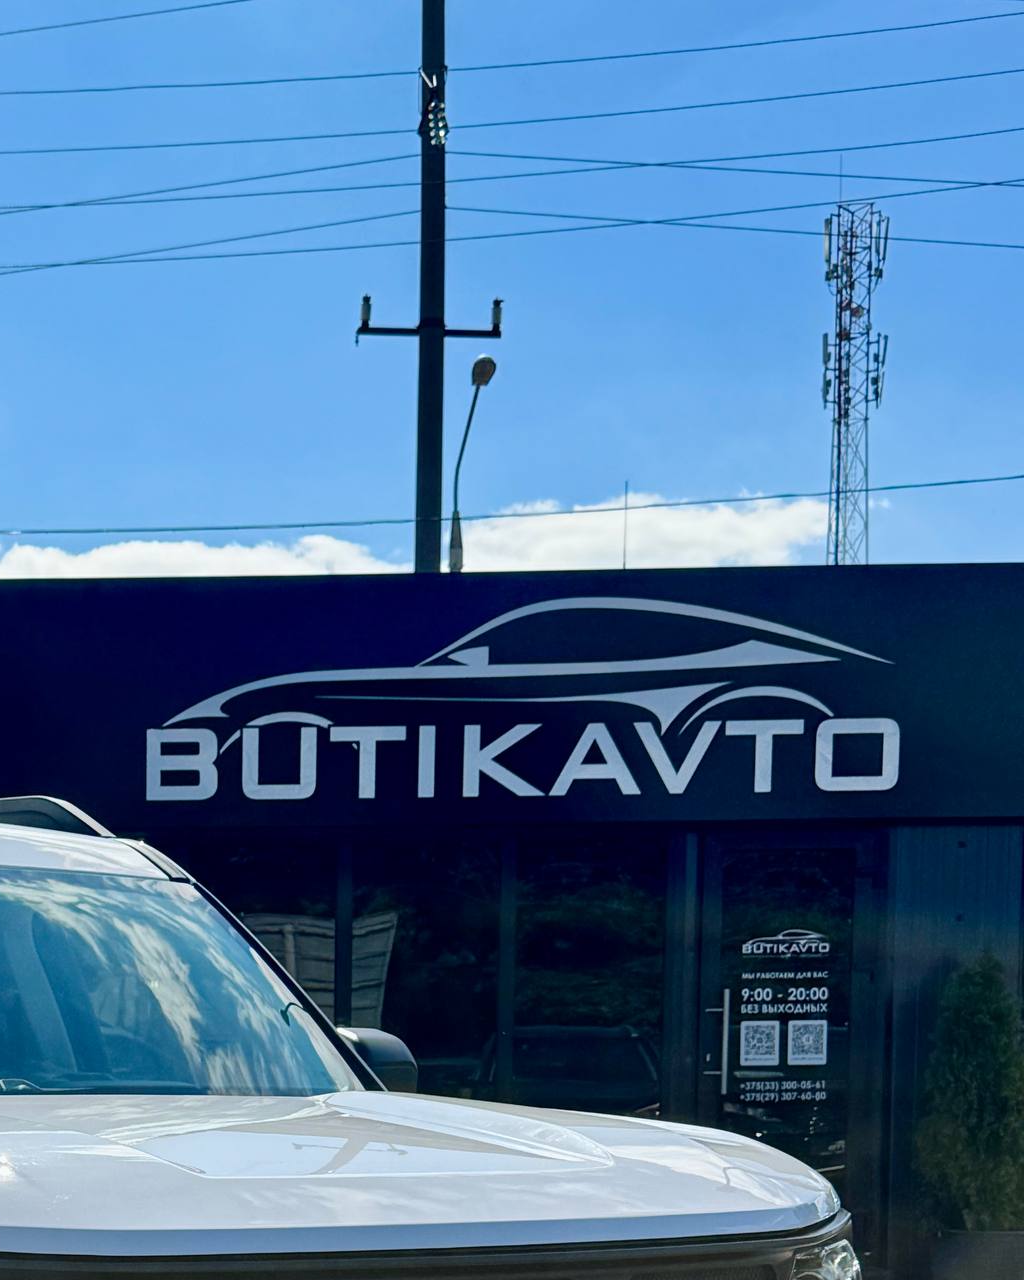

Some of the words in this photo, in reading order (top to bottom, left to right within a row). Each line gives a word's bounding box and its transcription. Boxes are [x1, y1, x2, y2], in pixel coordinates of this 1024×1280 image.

[146, 717, 900, 801] BUTIKAVTO
[742, 942, 830, 954] BUTIKAVTO
[741, 988, 773, 1002] 9:00
[787, 986, 828, 1001] 20:00
[741, 1003, 759, 1014] БЕЗ
[761, 1003, 828, 1014] ВЫХОДНЫХ
